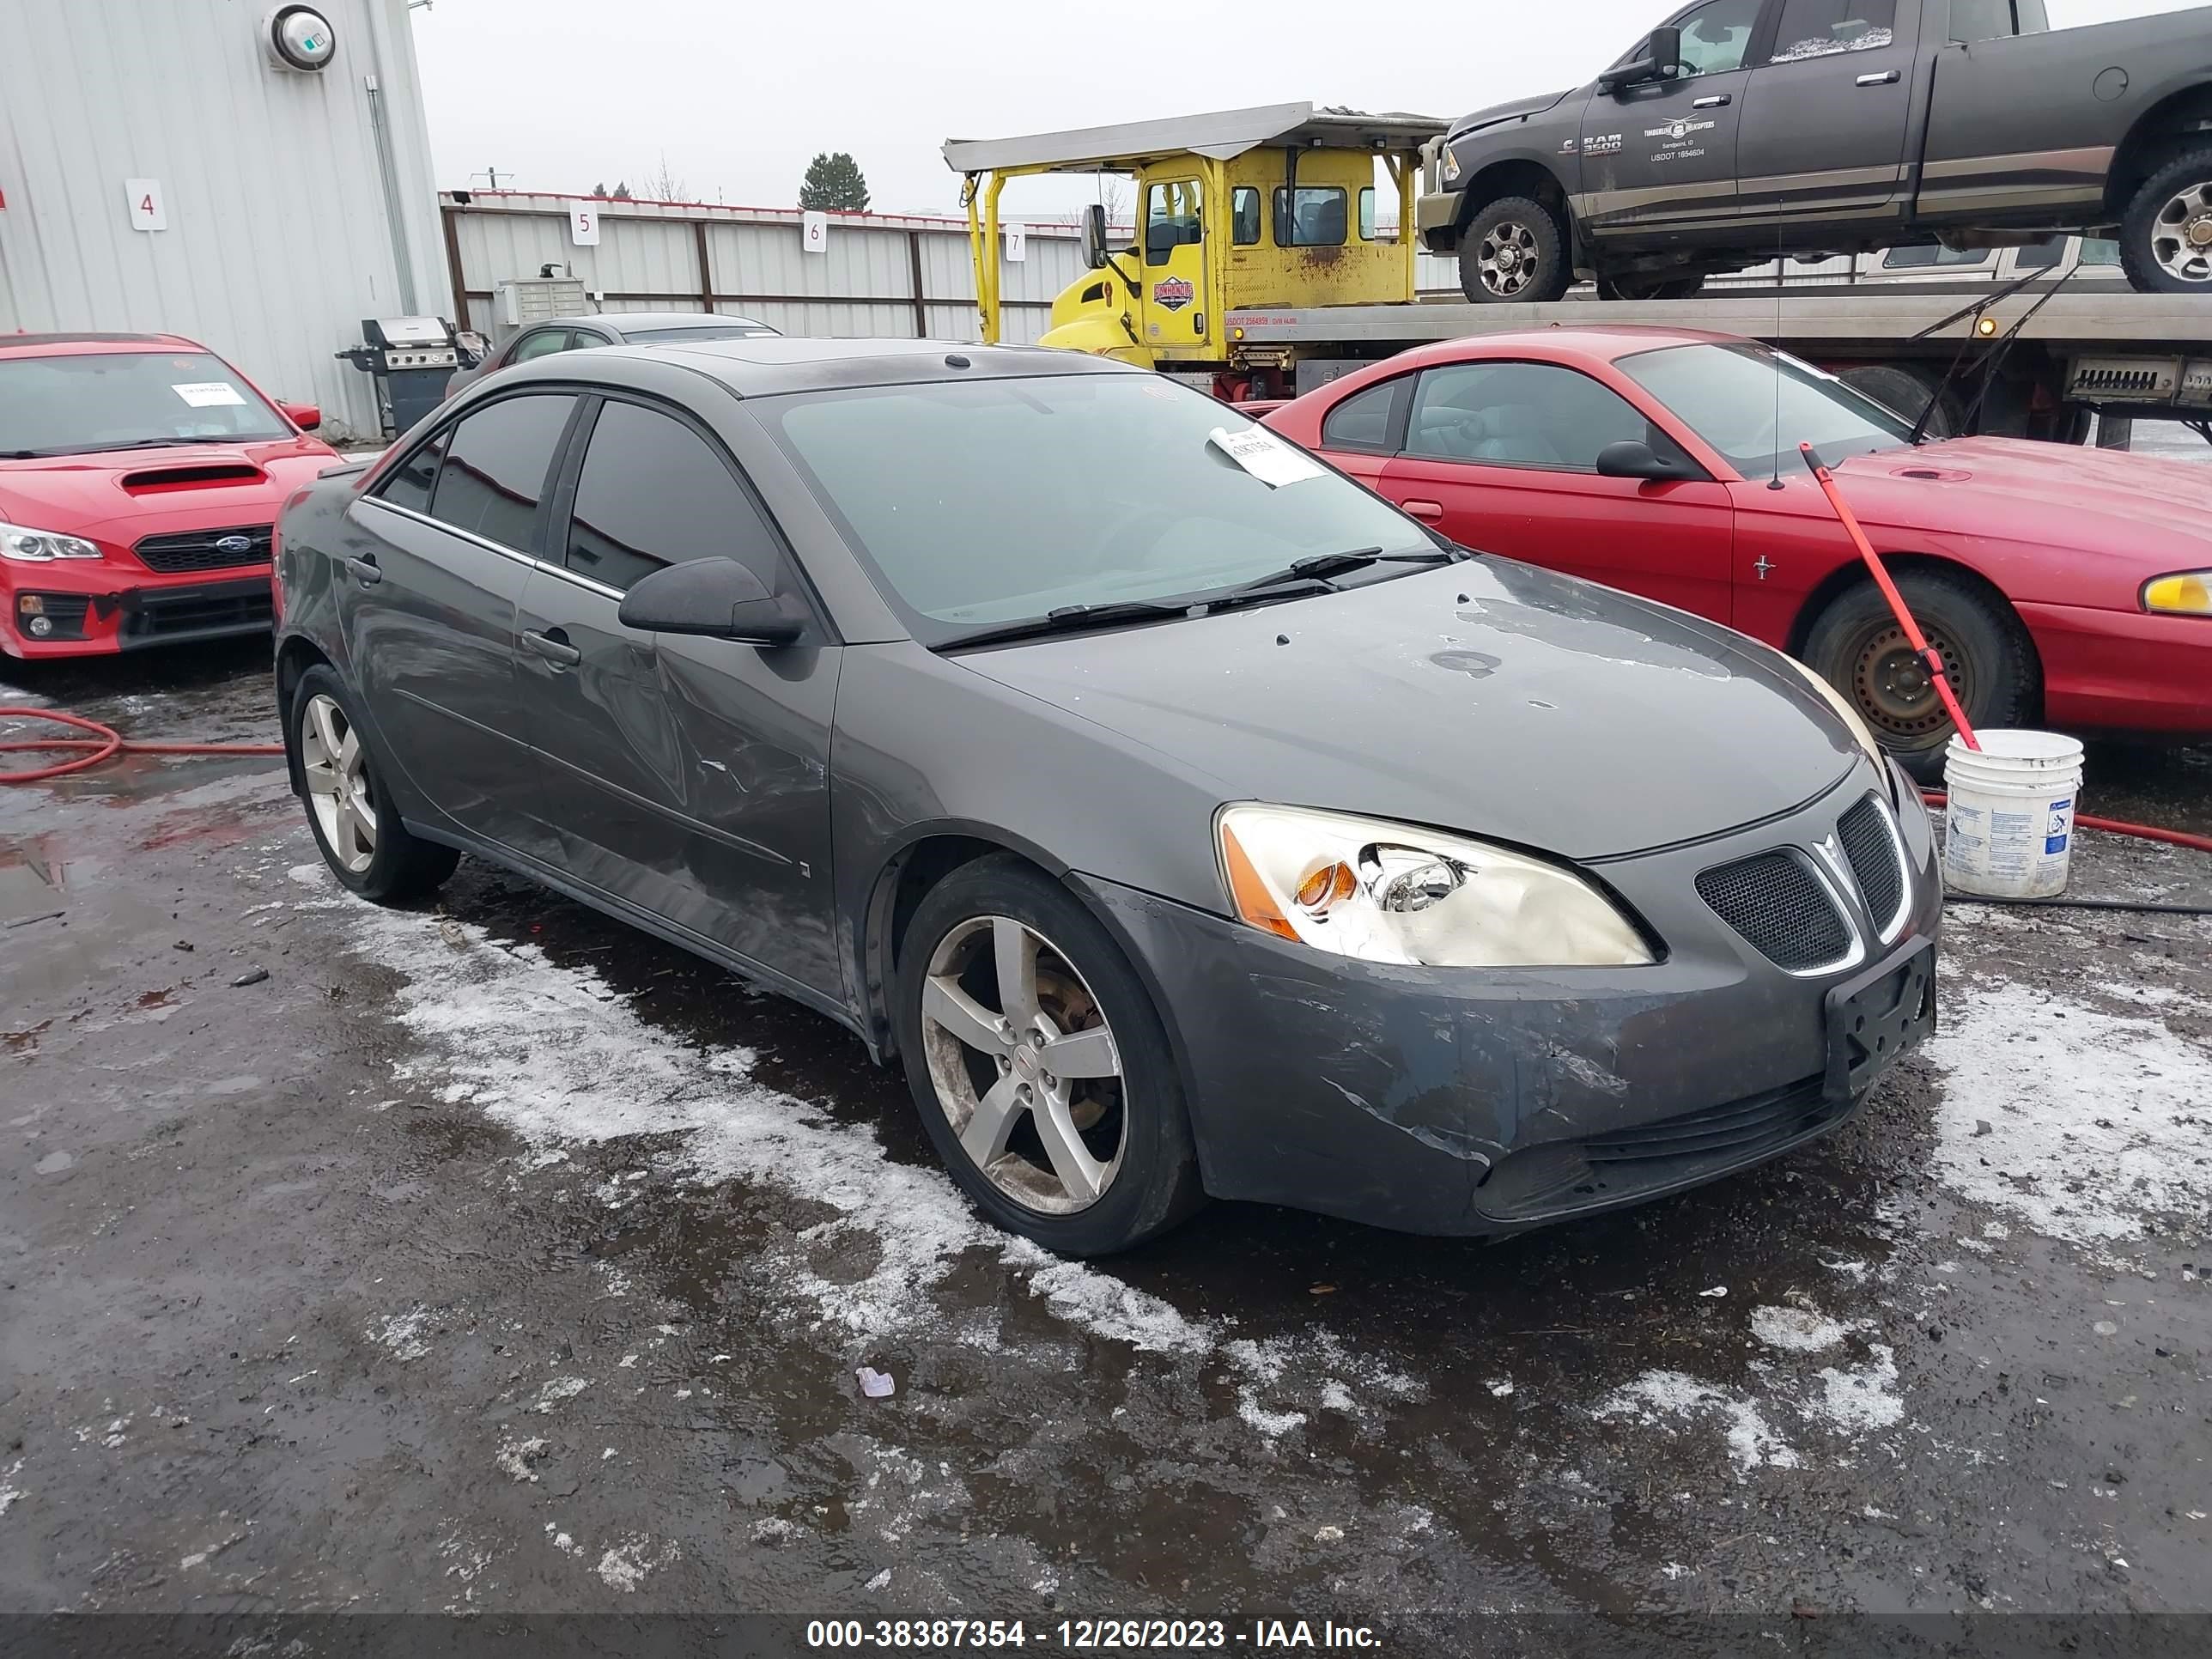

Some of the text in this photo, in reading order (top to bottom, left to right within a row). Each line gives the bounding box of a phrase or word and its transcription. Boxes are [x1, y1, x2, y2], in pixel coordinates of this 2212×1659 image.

[1583, 134, 1622, 145] RAM
[1583, 142, 1621, 152] 3500
[1650, 152, 1676, 162] USDOT
[141, 194, 154, 216] 4
[580, 213, 590, 233] 5
[811, 223, 819, 240] 6
[1012, 234, 1019, 251] 7
[1224, 316, 1244, 325] USDOT
